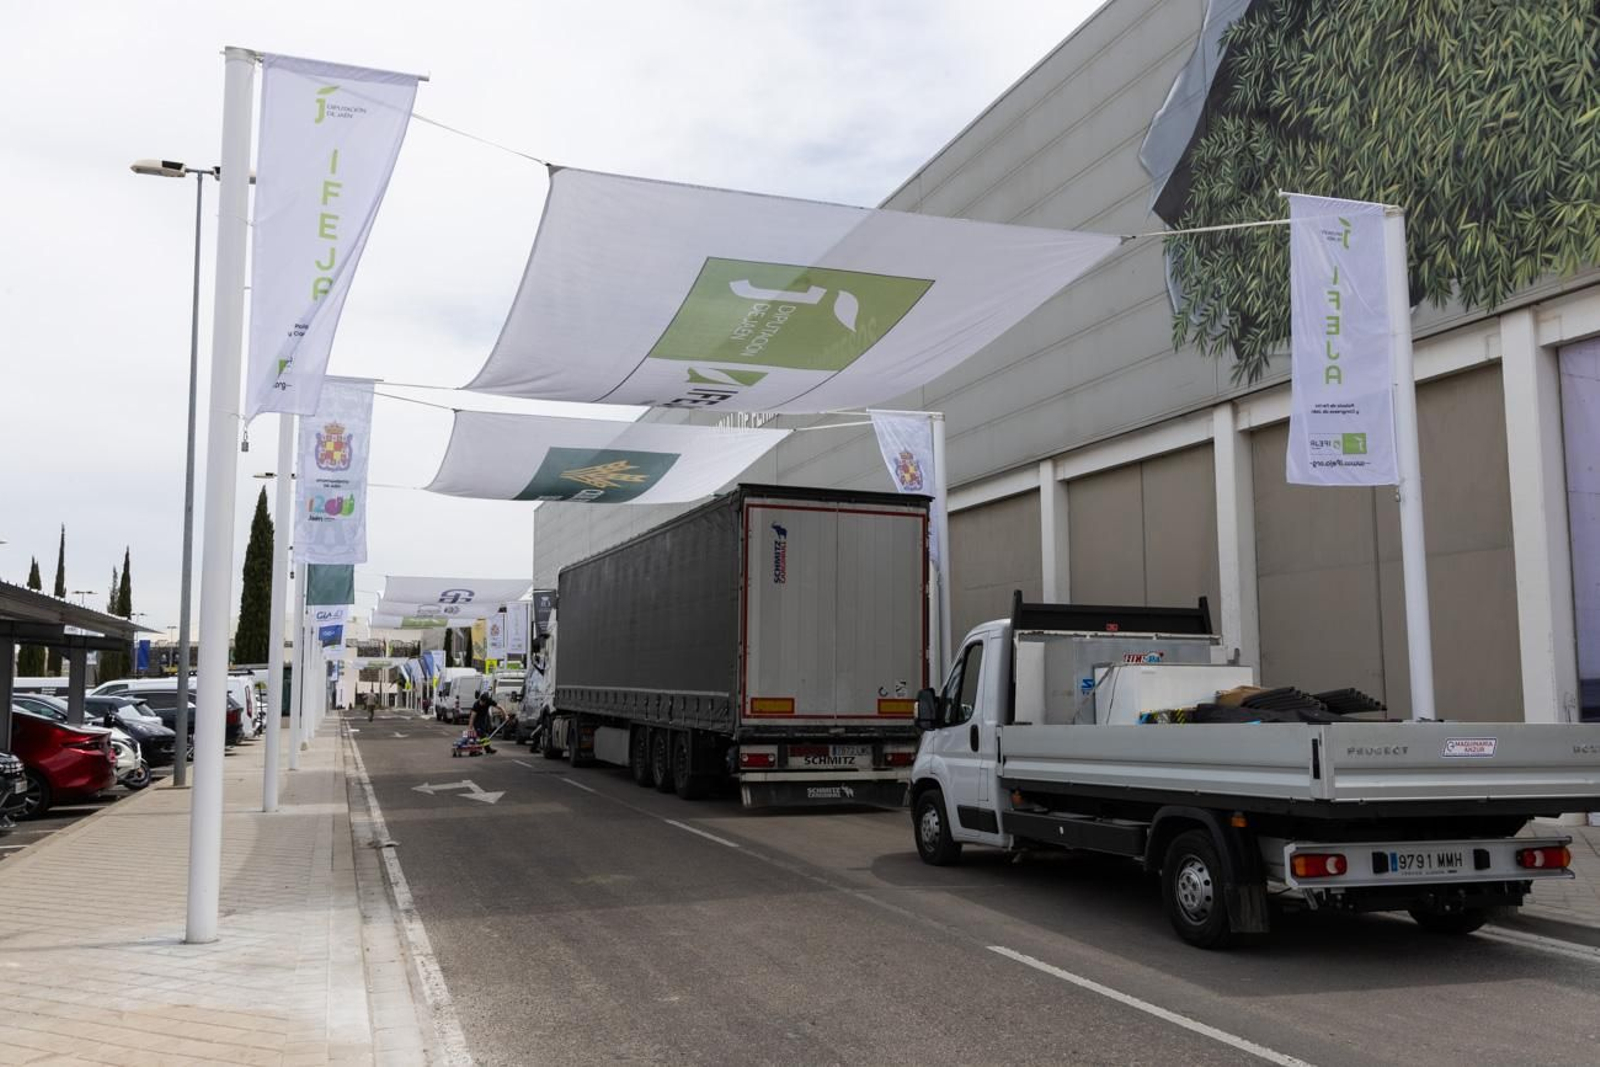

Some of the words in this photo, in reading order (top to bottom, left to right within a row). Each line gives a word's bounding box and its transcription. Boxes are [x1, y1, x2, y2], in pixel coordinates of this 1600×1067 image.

[773, 540, 781, 584] SCHMITZ
[804, 756, 856, 765] SCHMITZ
[1398, 853, 1432, 870] 9791
[1436, 851, 1463, 868] MMH
